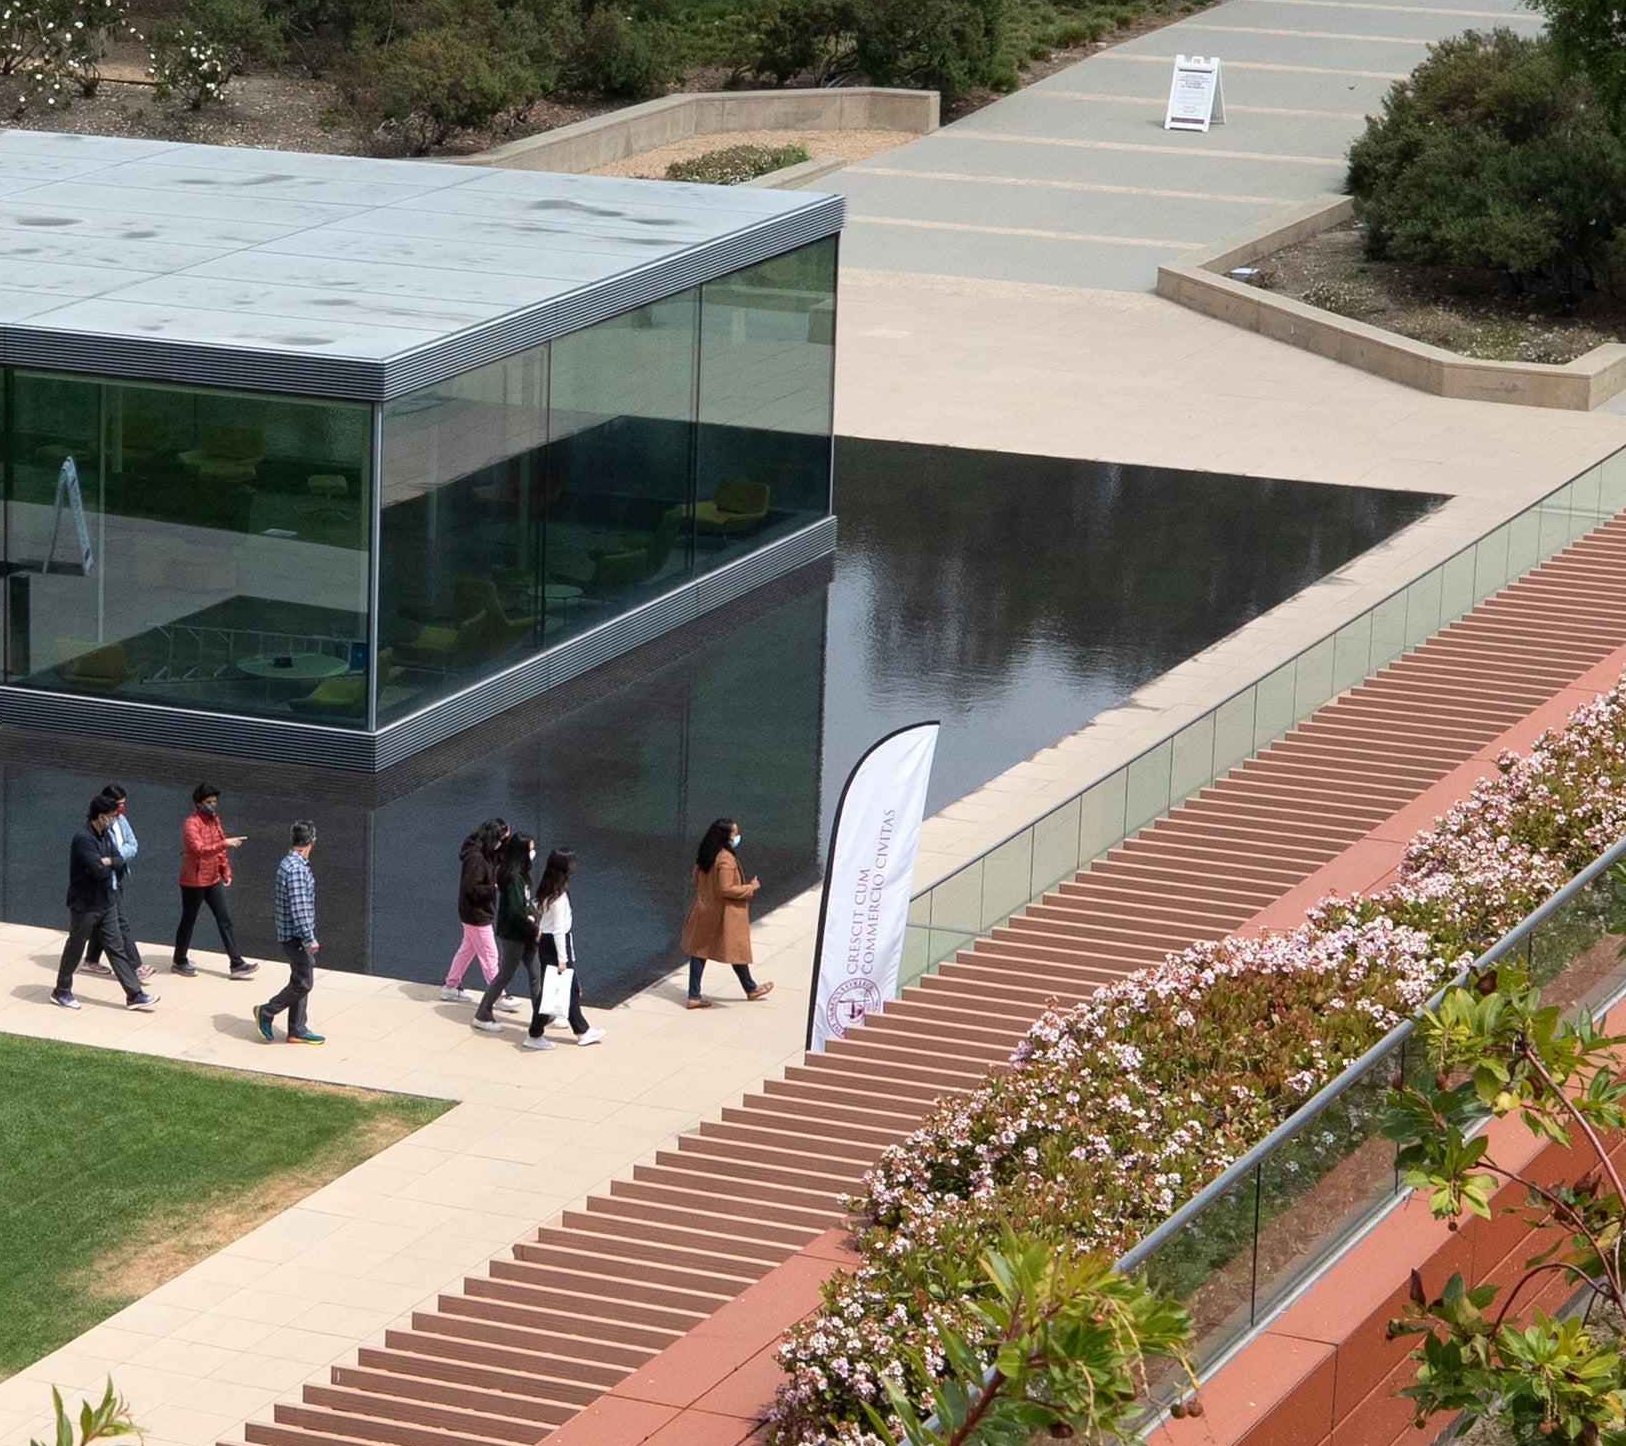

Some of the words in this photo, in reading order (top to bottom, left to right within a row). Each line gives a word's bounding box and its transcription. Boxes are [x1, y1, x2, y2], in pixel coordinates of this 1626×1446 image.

[855, 869, 870, 905] CUM
[861, 874, 885, 975] COMMERCIO
[875, 809, 895, 869] CIVITAS
[847, 912, 864, 975] CRESCIT
